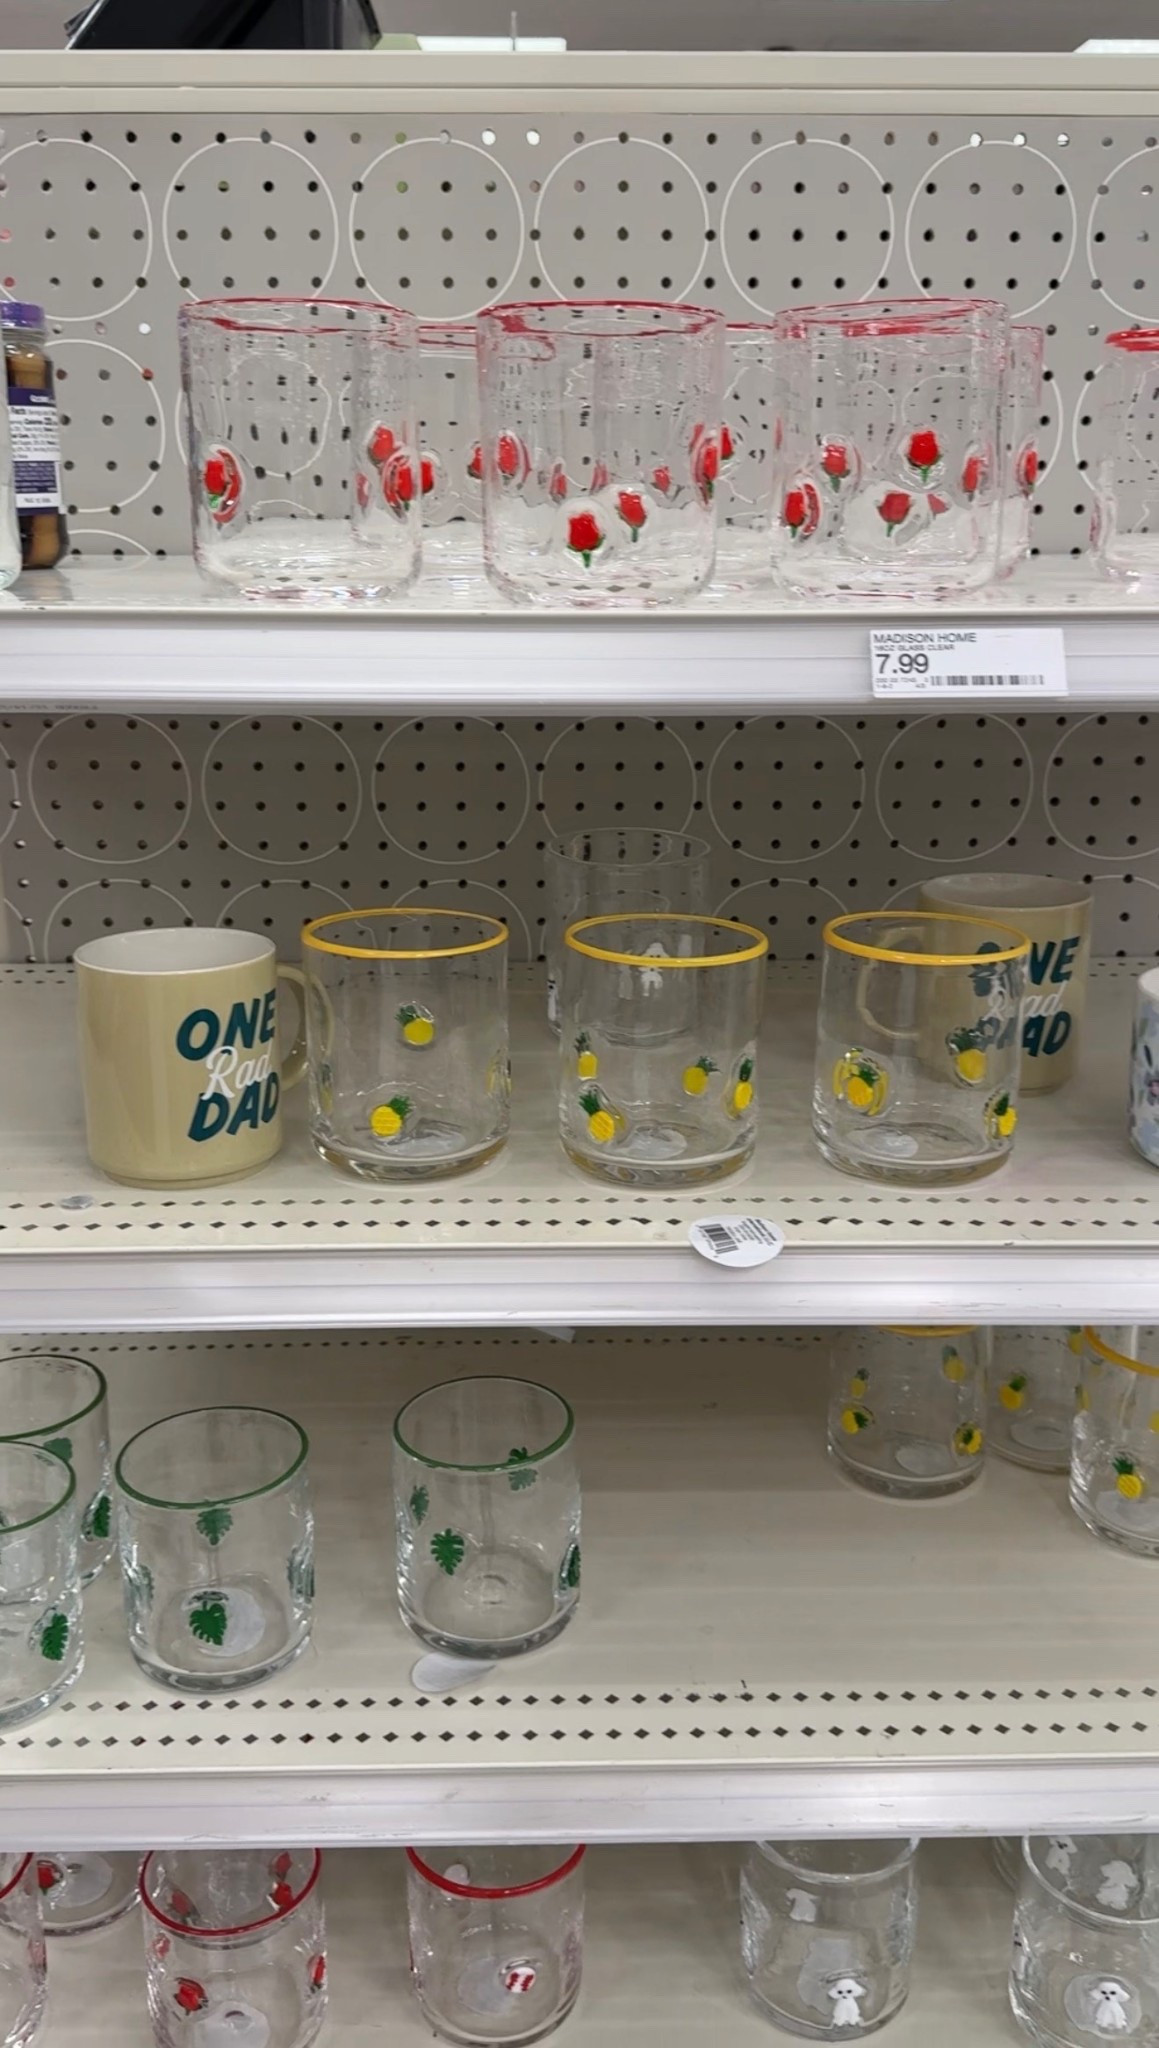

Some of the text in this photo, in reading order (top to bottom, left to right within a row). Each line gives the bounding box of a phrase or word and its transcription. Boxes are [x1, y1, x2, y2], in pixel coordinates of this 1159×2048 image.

[873, 632, 977, 643] MADISON HOME
[875, 653, 929, 674] 7.99
[176, 987, 276, 1061] ONE
[201, 1043, 273, 1100] Rad
[188, 1071, 279, 1142] DAD
